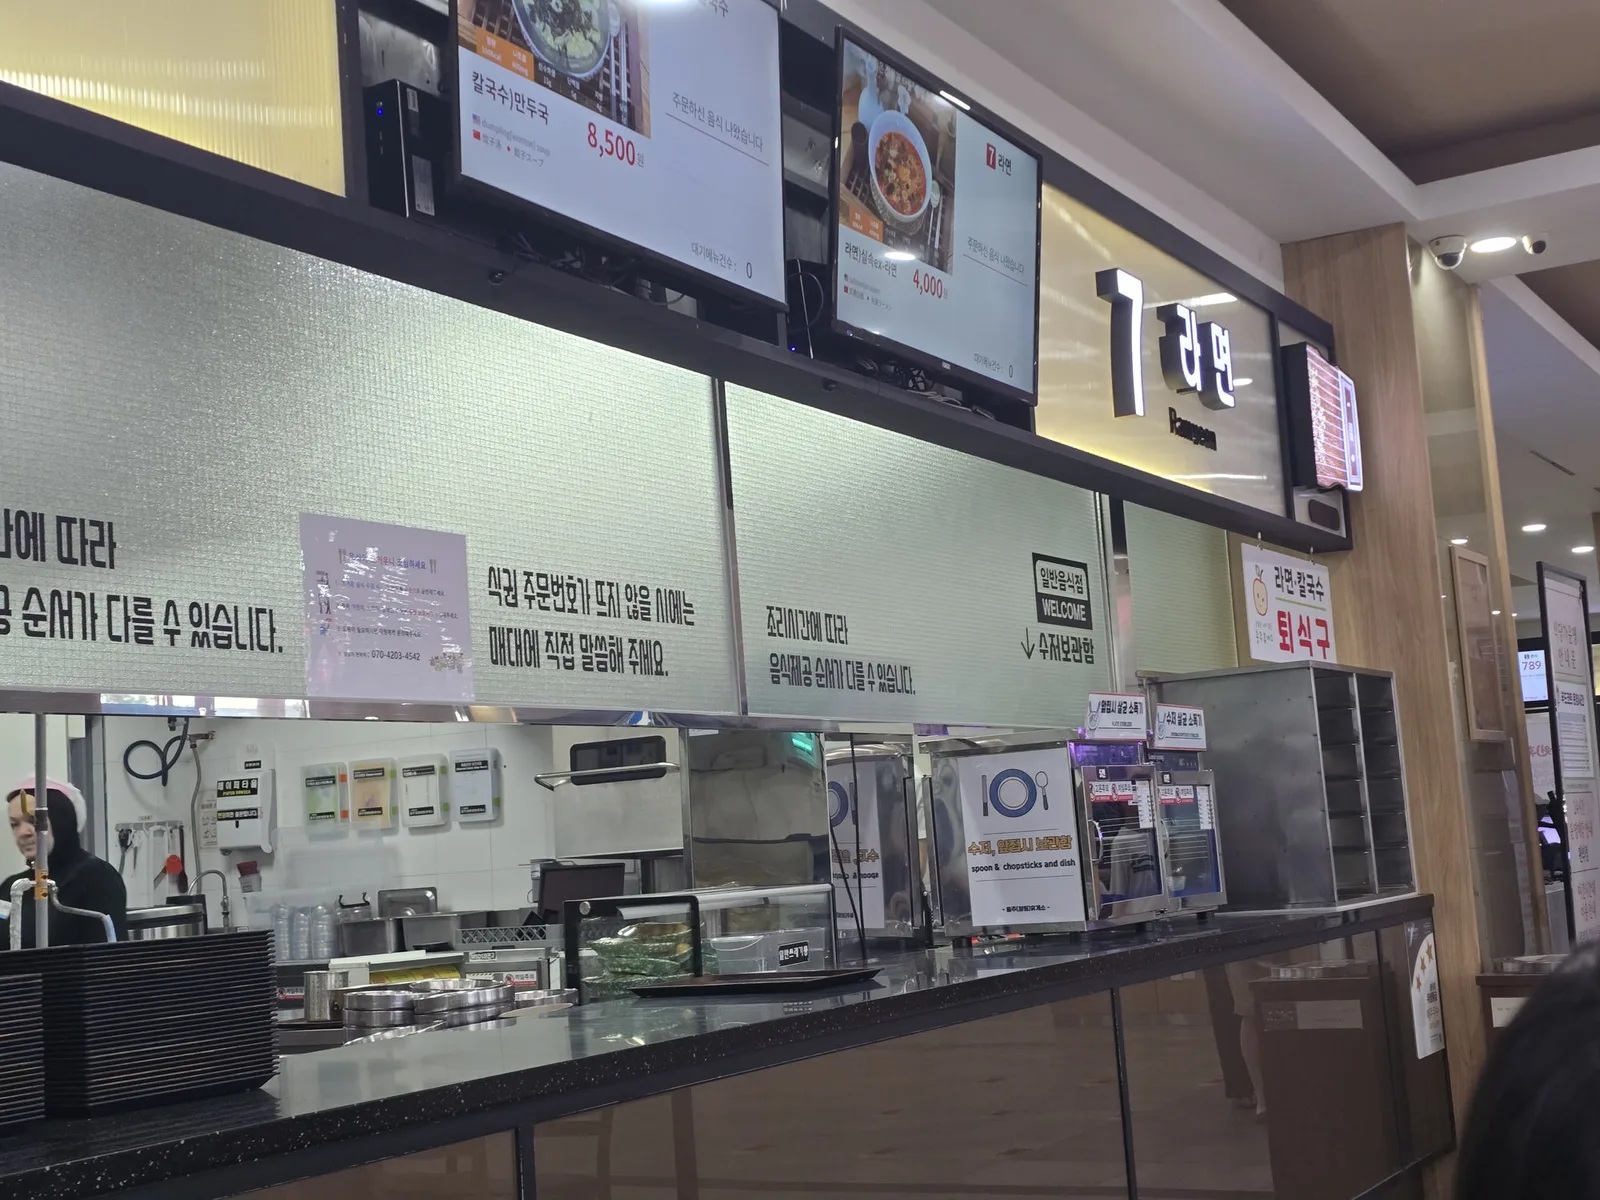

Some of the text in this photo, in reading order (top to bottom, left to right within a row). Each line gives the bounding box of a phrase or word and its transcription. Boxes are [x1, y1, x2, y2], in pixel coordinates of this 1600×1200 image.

[472, 71, 549, 125] 칼국수)만두국
[672, 92, 763, 152] 주문하신 음식 나왔습니다
[967, 236, 988, 258] 주문하신
[746, 262, 752, 279] 0
[1095, 268, 1236, 418] 7 라면
[1008, 364, 1014, 378] 0
[56, 515, 116, 569] 따라
[488, 566, 695, 626] 식권 주문번호가 뜨지 않을 시에는
[1040, 567, 1084, 594] 일반음식점
[22, 587, 98, 641] 순서가
[106, 594, 155, 645] 다를
[163, 599, 181, 647] 수
[188, 601, 284, 653] 있습니다.
[766, 605, 849, 645] 조리시간에 따라
[1042, 597, 1086, 621] WELCOME
[489, 626, 540, 668] 매대에
[545, 631, 575, 670] 직접
[579, 634, 625, 673] 말씀해
[628, 638, 668, 676] 주세요.
[1039, 632, 1095, 664] 수저보관함
[1277, 610, 1331, 660] 퇴식구
[371, 649, 421, 661] 070-4203-4542
[1522, 661, 1541, 670] 789
[769, 652, 916, 695] 음식제공 순서가 다를 수 있습니다.
[1166, 711, 1177, 726] 수저
[968, 841, 995, 856] 수저,
[1036, 835, 1072, 851] 보관함
[972, 858, 1076, 873] spoon & chopsticks and dish
